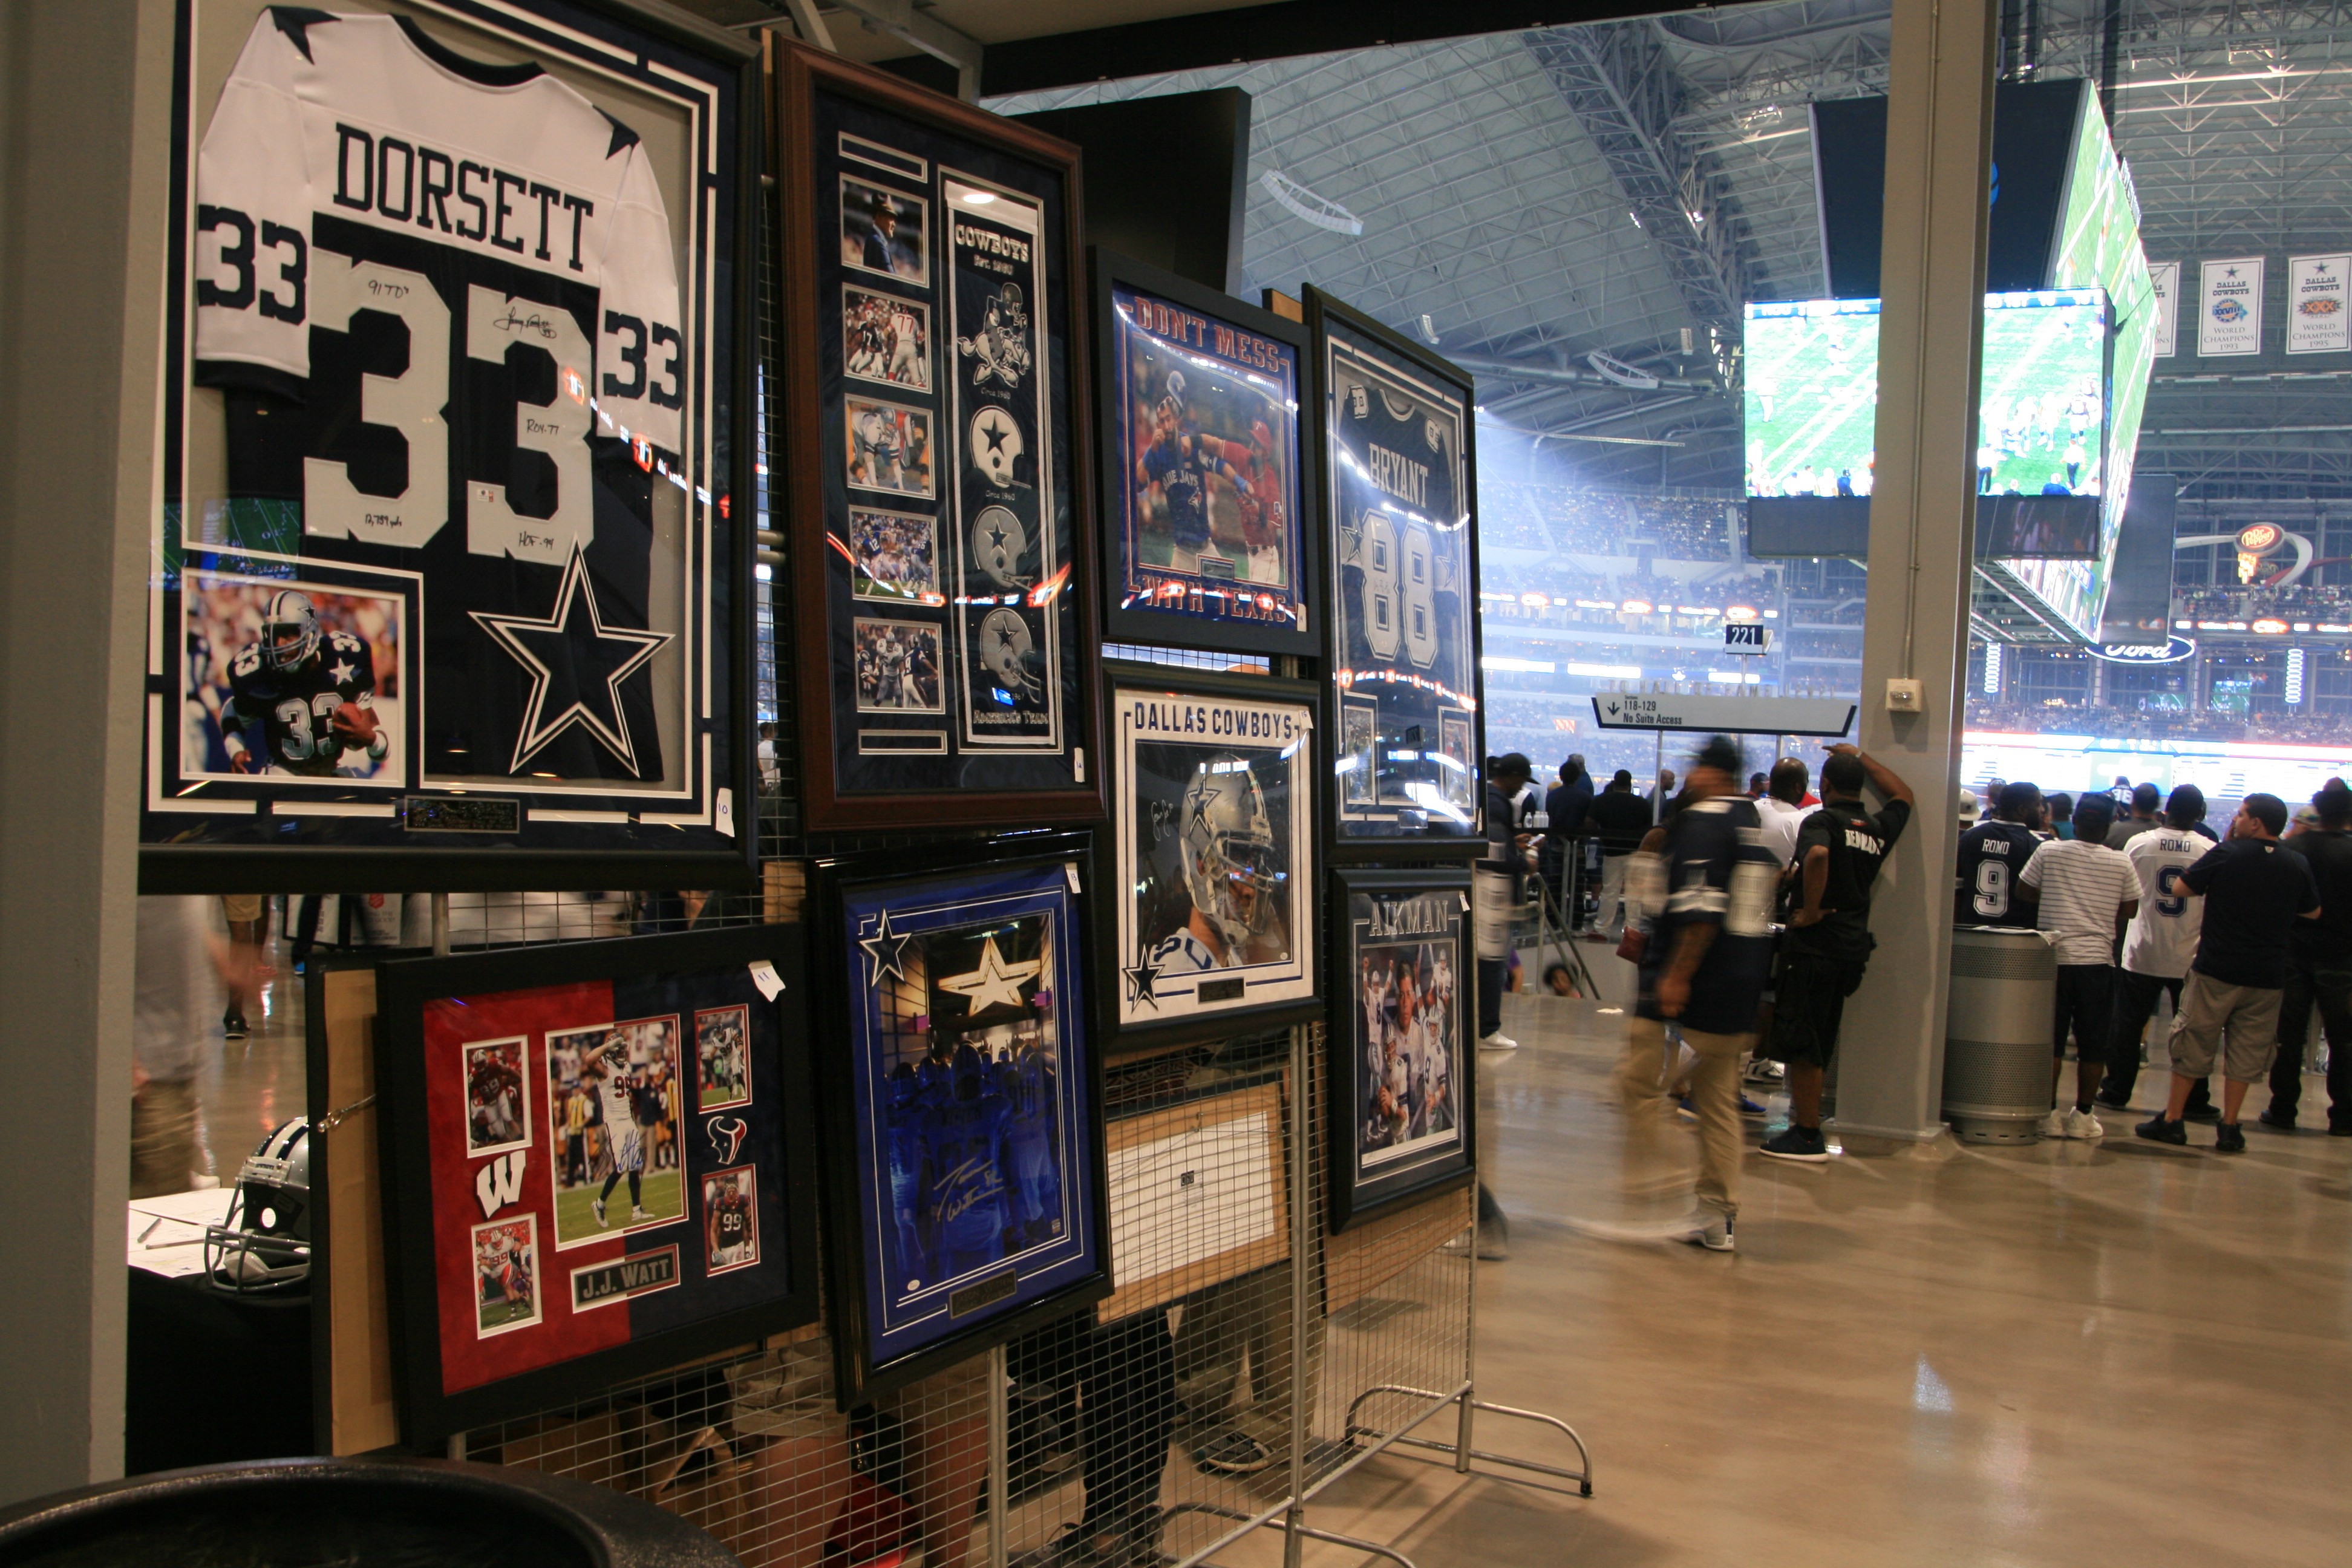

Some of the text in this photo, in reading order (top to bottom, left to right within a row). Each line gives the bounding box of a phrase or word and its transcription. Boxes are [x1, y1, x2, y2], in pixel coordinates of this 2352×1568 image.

[333, 123, 593, 272] DORSETT
[955, 224, 1029, 263] COWBOYS
[196, 204, 307, 327] 33
[2305, 301, 2335, 313] XXX
[897, 315, 913, 333] 77
[1135, 296, 1278, 373] DON'T MESS
[2203, 335, 2255, 344] CHAMPIONS
[2292, 332, 2346, 341] CHAMPIONS
[603, 311, 682, 411] 33
[304, 247, 593, 566] 33
[1369, 443, 1428, 509] BRYANT
[985, 490, 1000, 498] Circa
[2242, 531, 2273, 547] Pepper
[2253, 528, 2264, 537] Dr
[869, 538, 880, 551] 12
[1143, 575, 1287, 622] WITH TEXAS
[1362, 508, 1438, 670] 88
[1731, 627, 1756, 645] 221
[1624, 701, 1656, 711] 118-129
[1135, 702, 1292, 739] DALLAS COWBOYS
[1623, 713, 1682, 725] No Suite Access
[719, 803, 728, 814] 10
[1982, 838, 2010, 855] ROMO
[2160, 839, 2191, 852] ROMO
[1973, 859, 2009, 917] 9
[2155, 865, 2187, 917] 9
[1369, 900, 1448, 936] AIKMAN
[1425, 1056, 1431, 1084] 8
[477, 1150, 526, 1218] W
[723, 1214, 742, 1232] 99
[491, 1252, 508, 1264] 99
[583, 1258, 669, 1299] J.J. WATT
